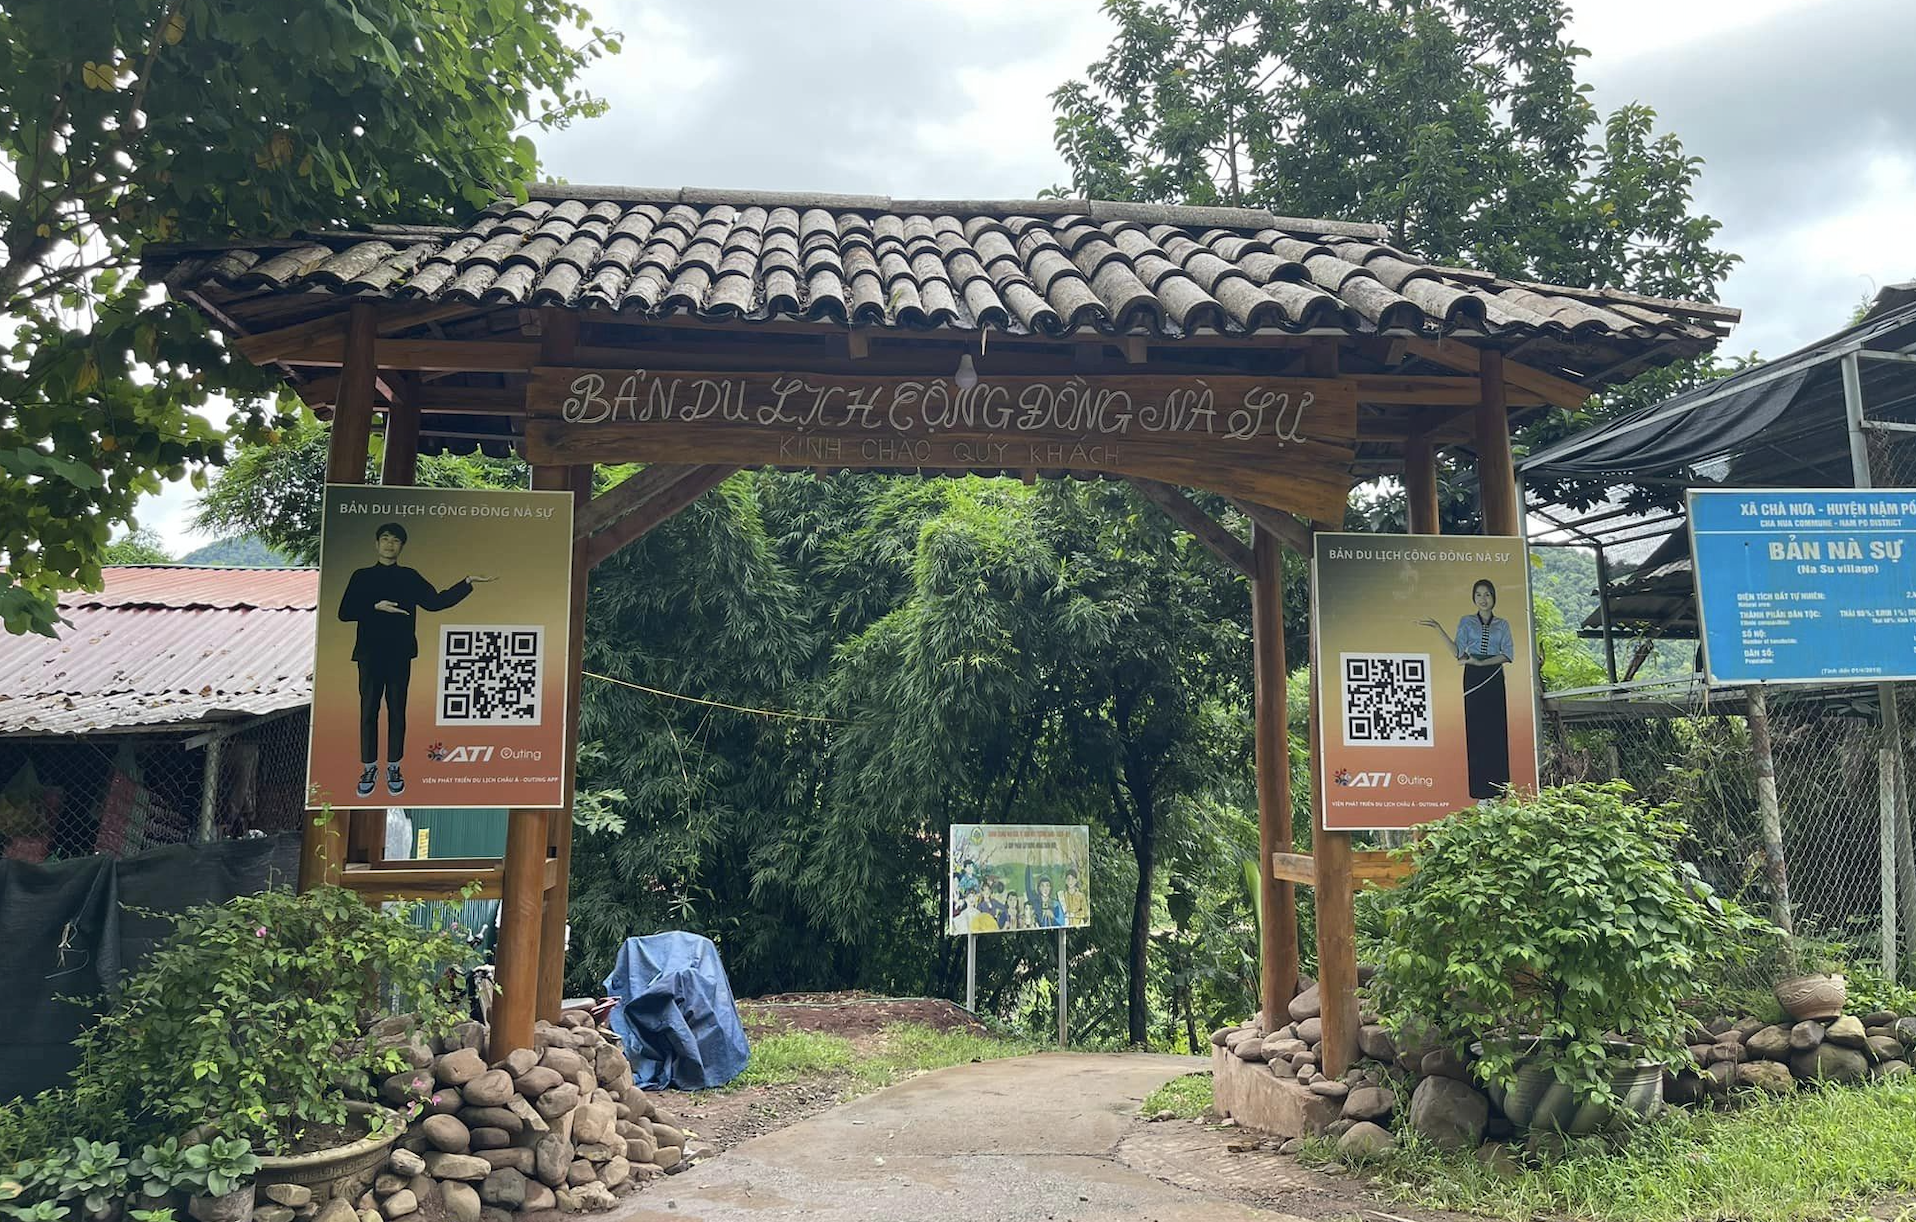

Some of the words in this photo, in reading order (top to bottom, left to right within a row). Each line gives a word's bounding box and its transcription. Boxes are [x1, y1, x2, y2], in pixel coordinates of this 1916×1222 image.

[562, 369, 681, 424] BẢN
[680, 379, 749, 421] DU
[757, 375, 883, 431] LỊCH
[889, 378, 1015, 433] CỘNG
[1017, 375, 1131, 434] ĐỒNG
[1138, 379, 1217, 433] NÀ
[1222, 386, 1315, 448] SỰ
[779, 429, 842, 461] KÍNH
[861, 433, 932, 463] CHÀO
[1030, 435, 1121, 465] KHÁCH
[339, 500, 369, 514] BẢN
[372, 504, 391, 515] DU
[395, 503, 425, 518] LỊCH
[429, 502, 467, 519] CỘNG
[471, 503, 510, 518] ĐỒNG
[536, 507, 555, 520] SỰ
[1740, 501, 1758, 516] XÃ
[1761, 501, 1786, 516] CHÀ
[1789, 502, 1815, 516] NƯA
[1827, 501, 1867, 518] HUYỆN
[1870, 501, 1898, 518] NẬM
[1760, 519, 1777, 528] CHA
[1777, 519, 1793, 528] NUA
[1795, 519, 1833, 527] COMMUNE
[1839, 519, 1857, 527] NAM
[1858, 519, 1869, 527] PO
[1870, 518, 1902, 527] DISTRICT
[1329, 547, 1353, 560] BẢN
[1356, 550, 1372, 560] DU
[1375, 550, 1400, 563] LỊCH
[1404, 549, 1436, 563] CỘNG
[1768, 534, 1821, 560] BẢN
[1827, 537, 1863, 560] NÀ
[1869, 538, 1904, 563] SỰ
[1797, 564, 1817, 574] (Na
[1820, 564, 1834, 574] Su
[1837, 564, 1879, 574] village)
[442, 745, 494, 762] ATI
[500, 747, 542, 761] Outing
[1349, 772, 1392, 787] ATI
[1397, 774, 1433, 787] Outing
